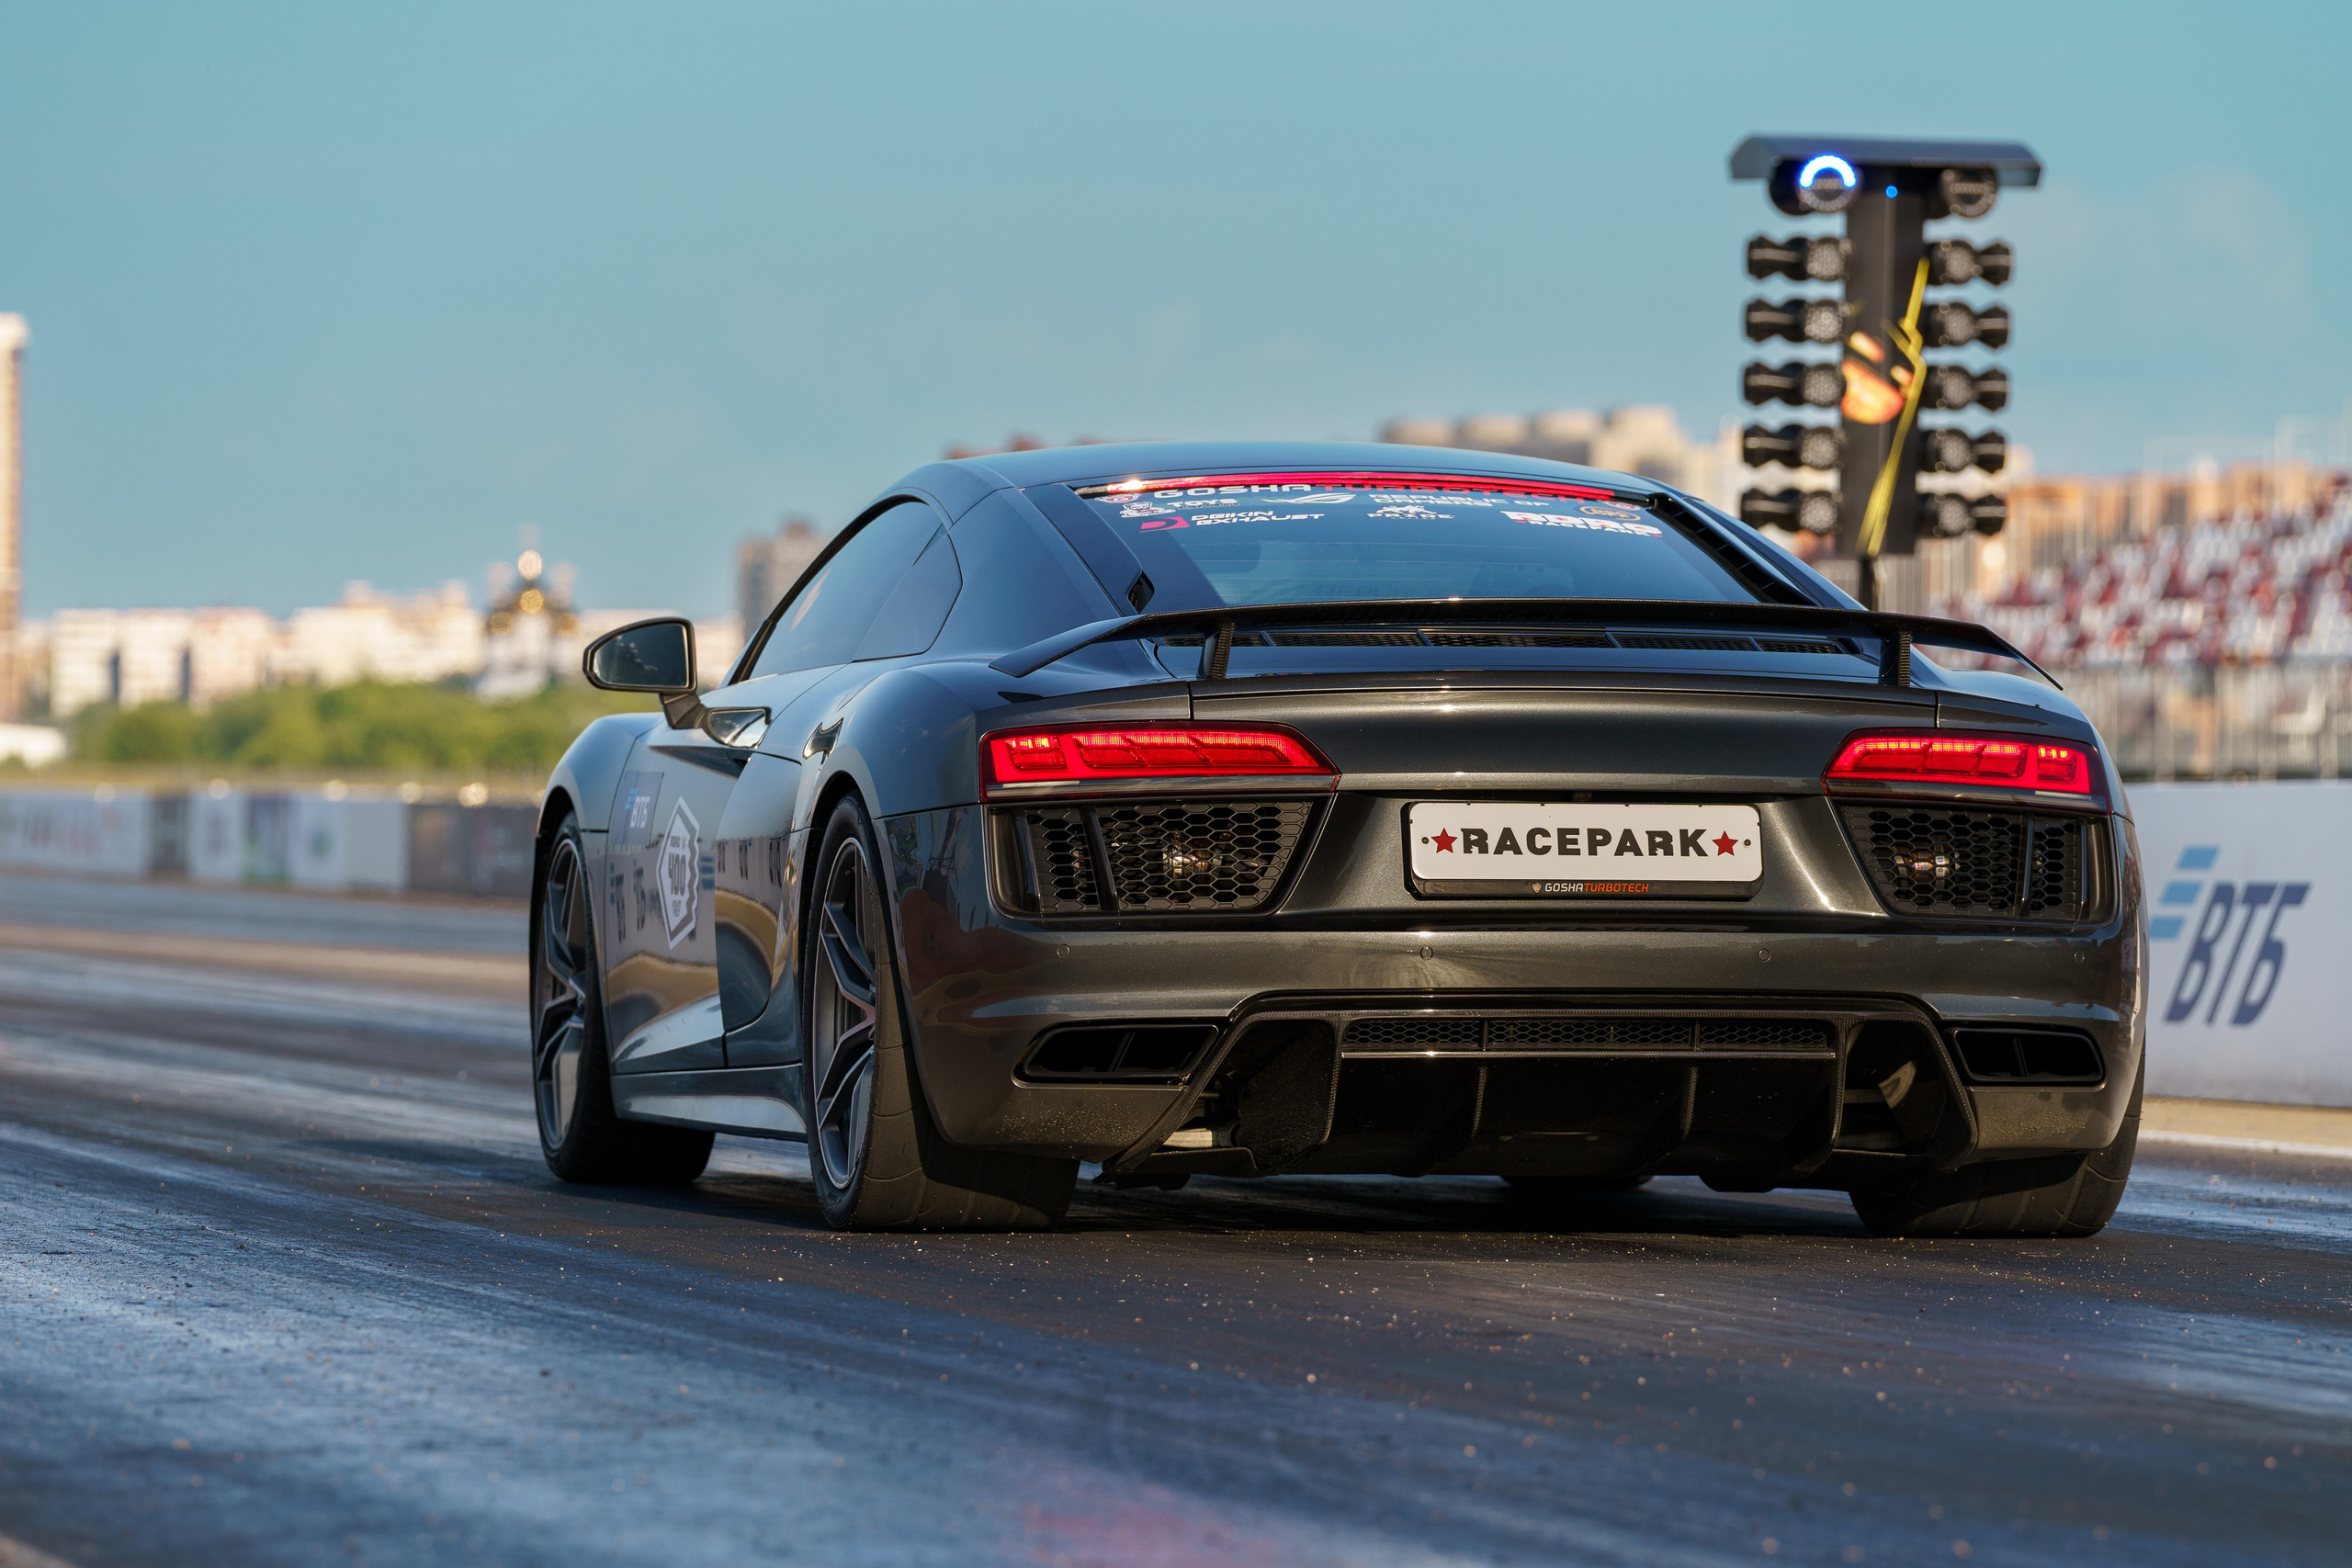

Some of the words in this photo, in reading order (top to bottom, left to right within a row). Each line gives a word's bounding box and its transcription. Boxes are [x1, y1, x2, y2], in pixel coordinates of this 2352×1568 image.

[1167, 499, 1238, 509] TOYS
[1369, 494, 1509, 504] REPUBLIC
[1374, 498, 1493, 506] GAMERS
[1196, 513, 1324, 525] EXHAUST
[1529, 520, 1651, 536] RACEPARK
[1460, 827, 1709, 857] RACEPARK
[669, 852, 686, 897] 400
[2165, 882, 2312, 1027] ВТБ
